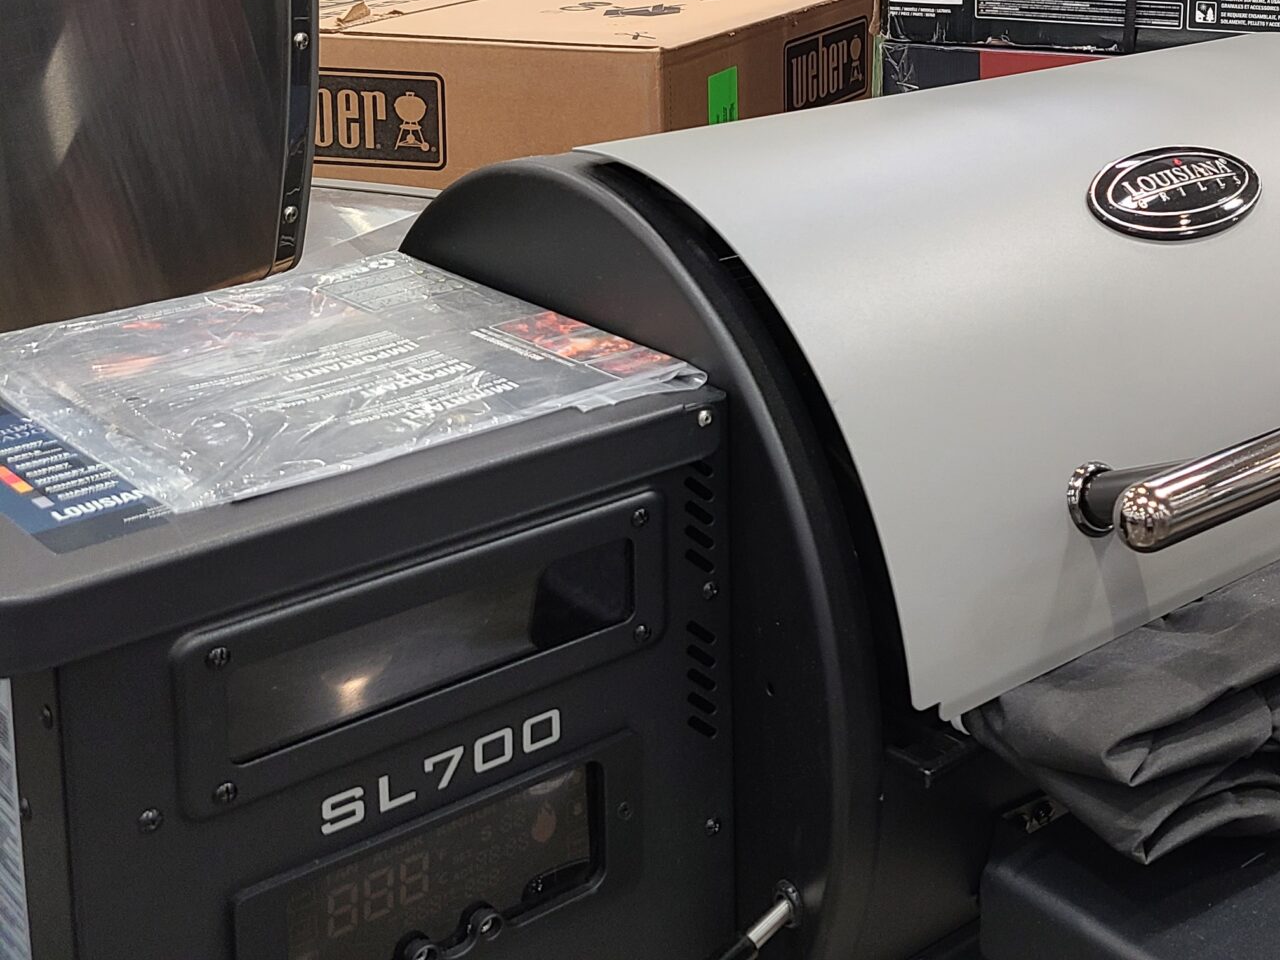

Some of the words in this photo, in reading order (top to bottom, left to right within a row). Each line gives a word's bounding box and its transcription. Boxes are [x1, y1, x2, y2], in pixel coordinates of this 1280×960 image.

[792, 34, 847, 108] weber
[315, 88, 386, 149] ber
[1122, 158, 1232, 196] LOUISIANA
[50, 489, 146, 522] LOUISIAN
[320, 707, 561, 837] SL700
